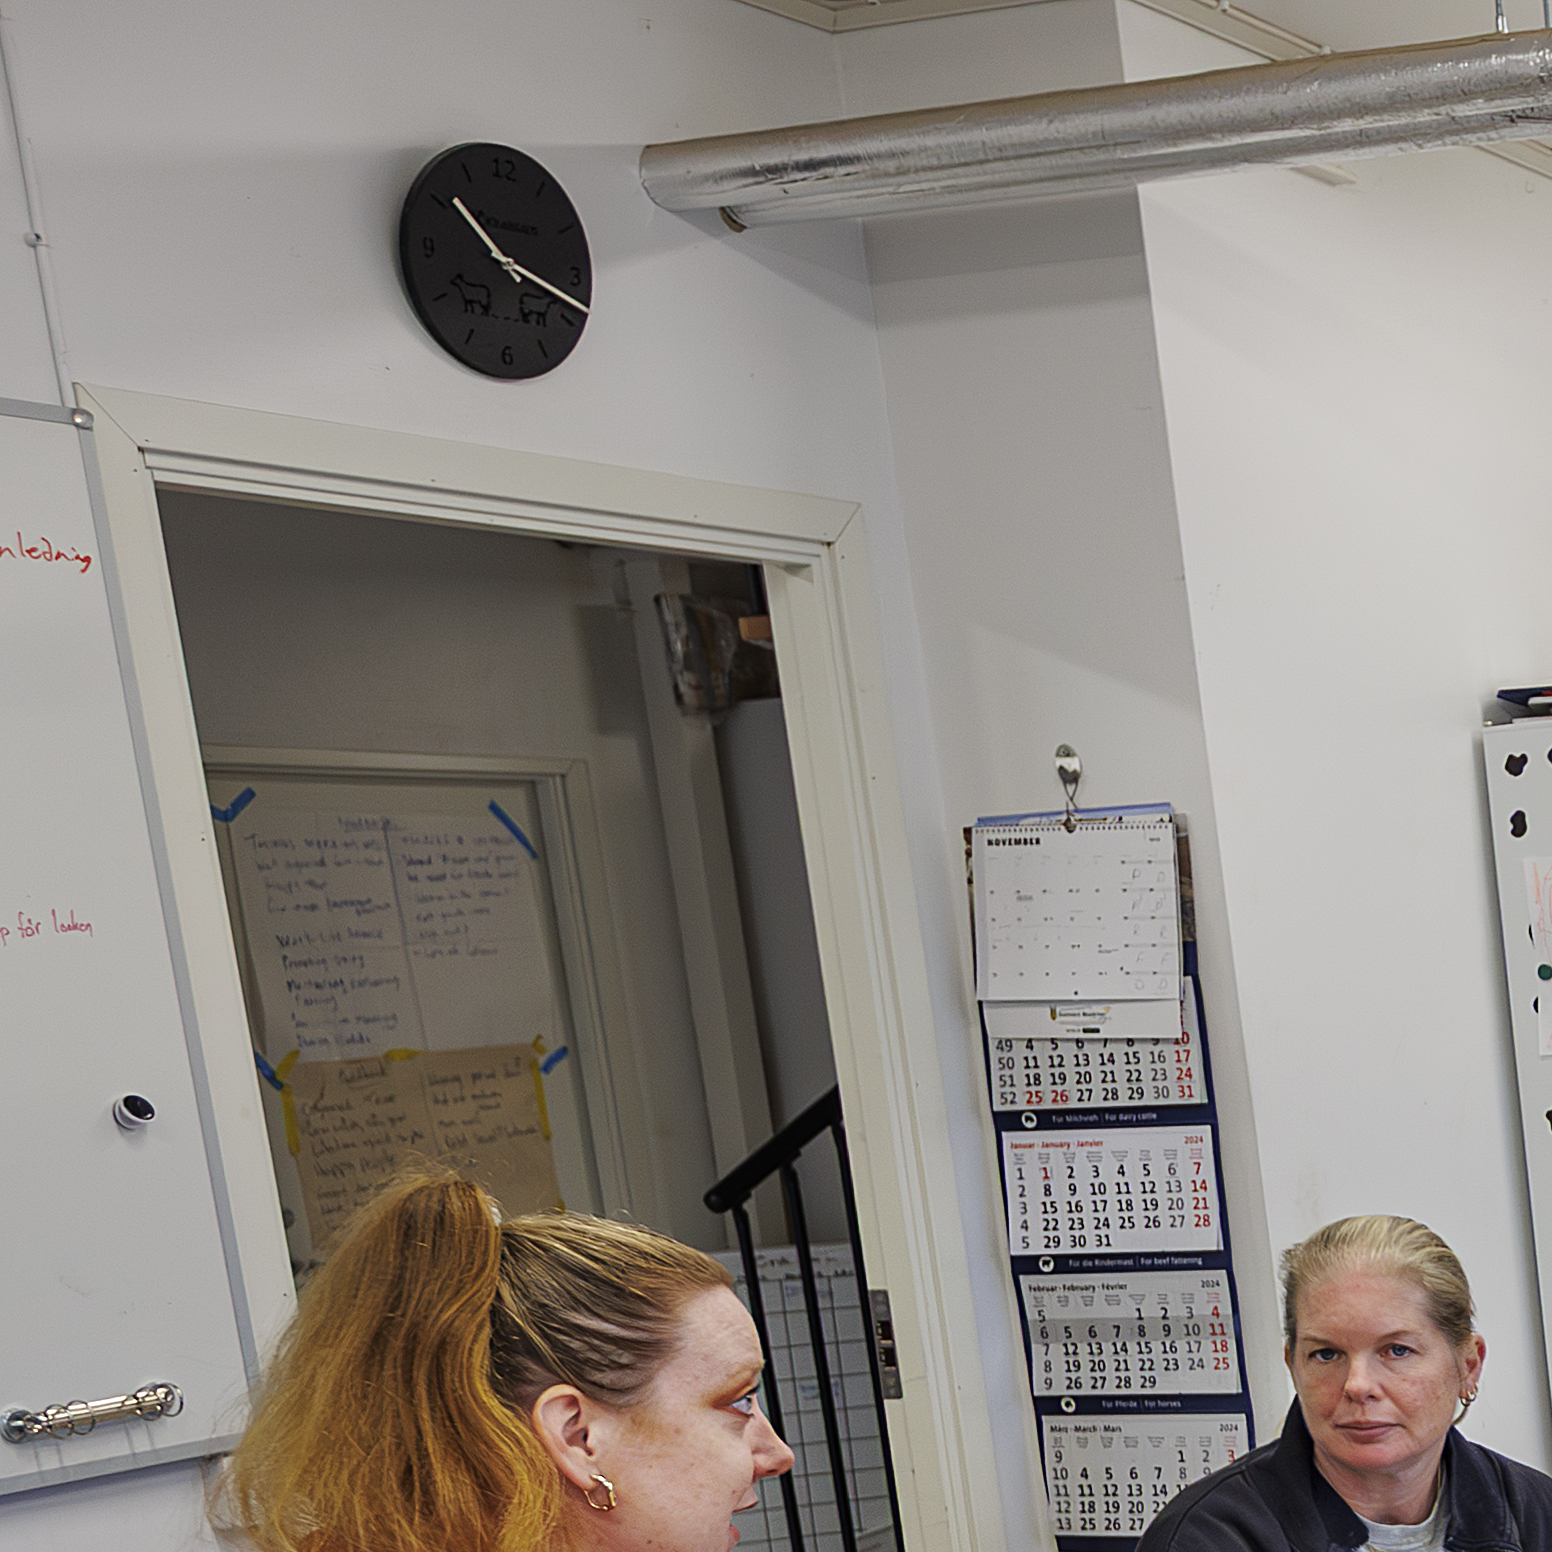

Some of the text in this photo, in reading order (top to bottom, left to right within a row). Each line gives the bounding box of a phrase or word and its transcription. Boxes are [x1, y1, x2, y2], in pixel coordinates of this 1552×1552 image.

[492, 158, 517, 181] 12
[423, 236, 435, 258] 9
[570, 267, 581, 287] 3
[501, 346, 514, 366] 6
[987, 838, 1041, 847] NOVEMBER
[17, 911, 41, 938] för
[1025, 1067, 1192, 1087] 18 19 20 21 22 23 24
[1026, 1085, 1194, 1104] 25 26 27 28 29 30 31
[1184, 1136, 1204, 1144] 2024
[1042, 1162, 1201, 1180] 1 2 3 4 5 6 7
[1044, 1179, 1207, 1197] 8 9 10 11 12 13 14
[1041, 1197, 1209, 1214] 15 16 17 18 19 20 21
[1043, 1214, 1210, 1231] 22 23 24 25 26 27 28
[1044, 1234, 1111, 1248] 29 30 31
[1028, 1284, 1057, 1293] Februar
[1062, 1283, 1096, 1293] February
[1201, 1279, 1220, 1288] 2024
[1136, 1306, 1220, 1321] 1 2 3 4
[1064, 1323, 1226, 1339] 5 6 7 8 9 10 11
[1063, 1339, 1228, 1356] 12 13 14 15 16 17 18
[1065, 1357, 1229, 1372] 19 20 21 22 23 24 25
[1066, 1376, 1156, 1390] 26 27 28 29
[1074, 1424, 1098, 1433] March
[1219, 1423, 1238, 1432] 2024
[1178, 1450, 1236, 1463] 1 2 3
[1080, 1467, 1186, 1480] 4 5 6 7 8
[1078, 1484, 1167, 1497] 11 12 13 14
[1079, 1501, 1144, 1514] 18 19 20
[1080, 1518, 1145, 1531] 25 26 27
